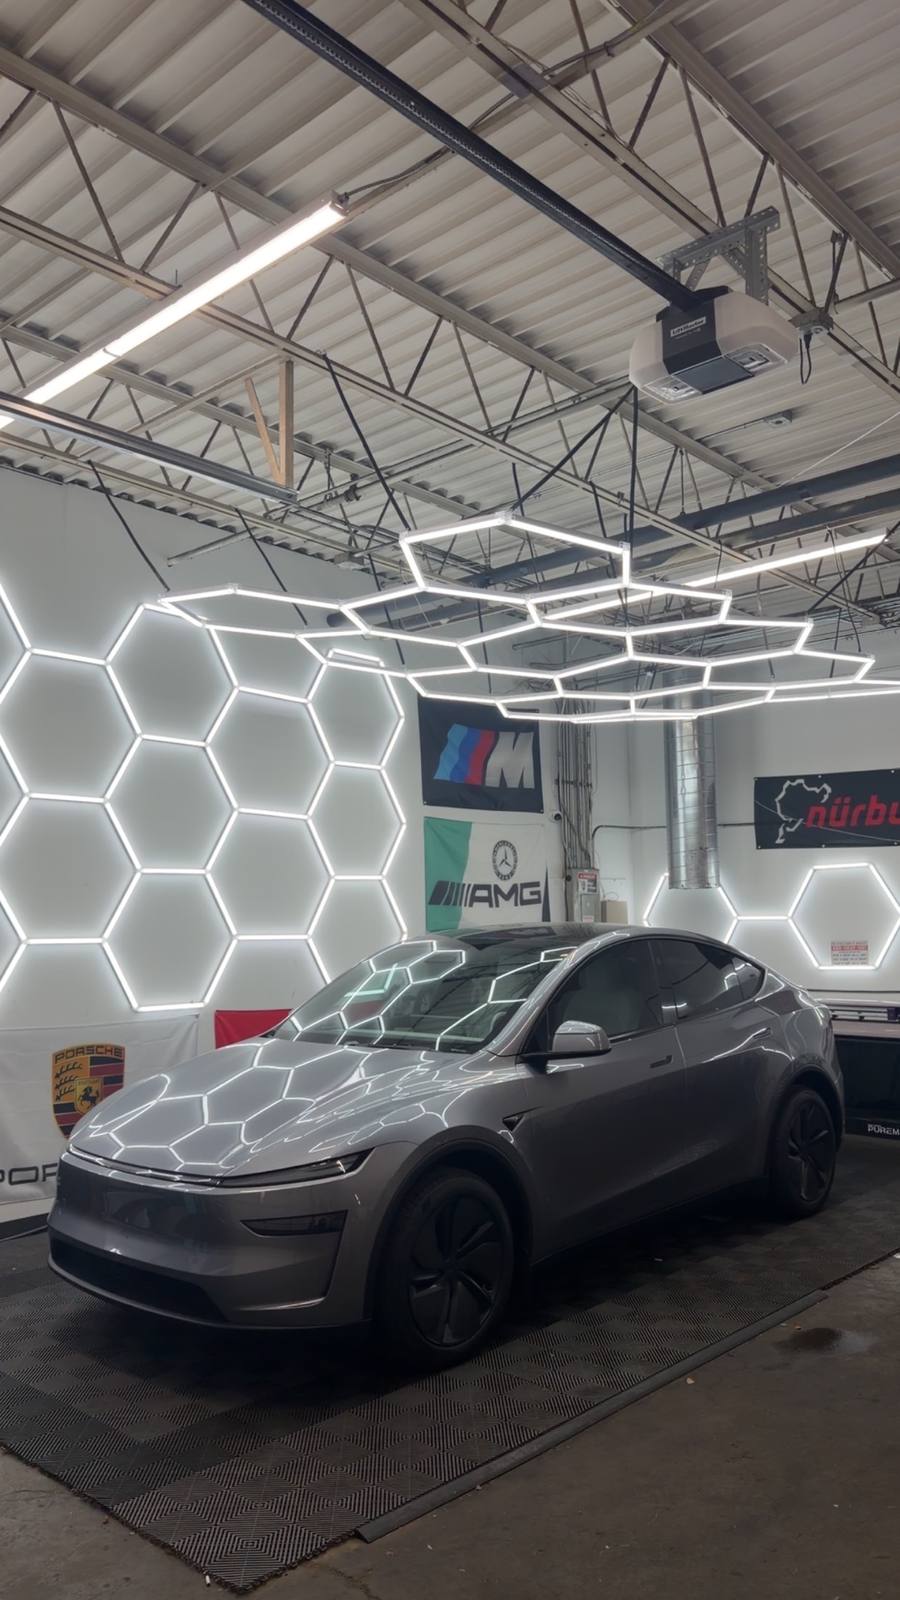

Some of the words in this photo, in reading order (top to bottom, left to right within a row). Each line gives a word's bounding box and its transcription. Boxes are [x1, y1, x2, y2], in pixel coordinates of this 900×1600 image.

[484, 730, 535, 789] M
[468, 881, 542, 908] AMG
[54, 1044, 123, 1064] PORSCHE
